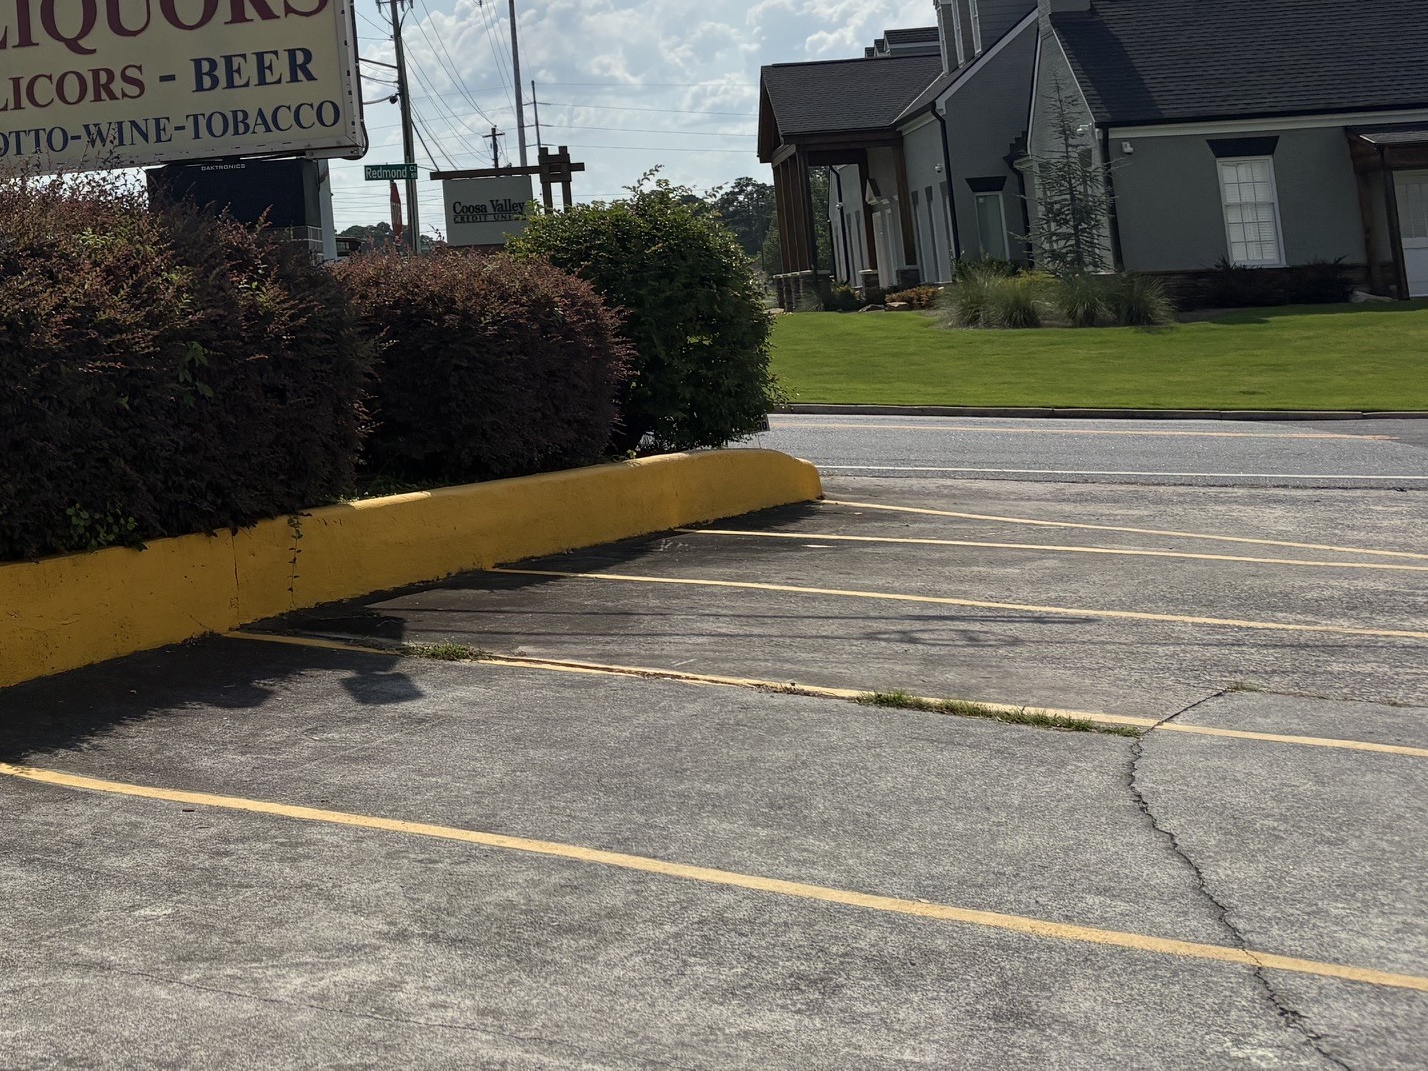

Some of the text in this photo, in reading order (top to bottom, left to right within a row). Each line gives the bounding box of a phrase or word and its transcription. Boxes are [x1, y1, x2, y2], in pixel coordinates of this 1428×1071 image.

[190, 47, 318, 93] BEER
[201, 163, 246, 171] DAKTRONICS
[365, 166, 407, 179] Redmond
[453, 199, 525, 215] Coosa Valley
[453, 215, 487, 223] CREDIT
